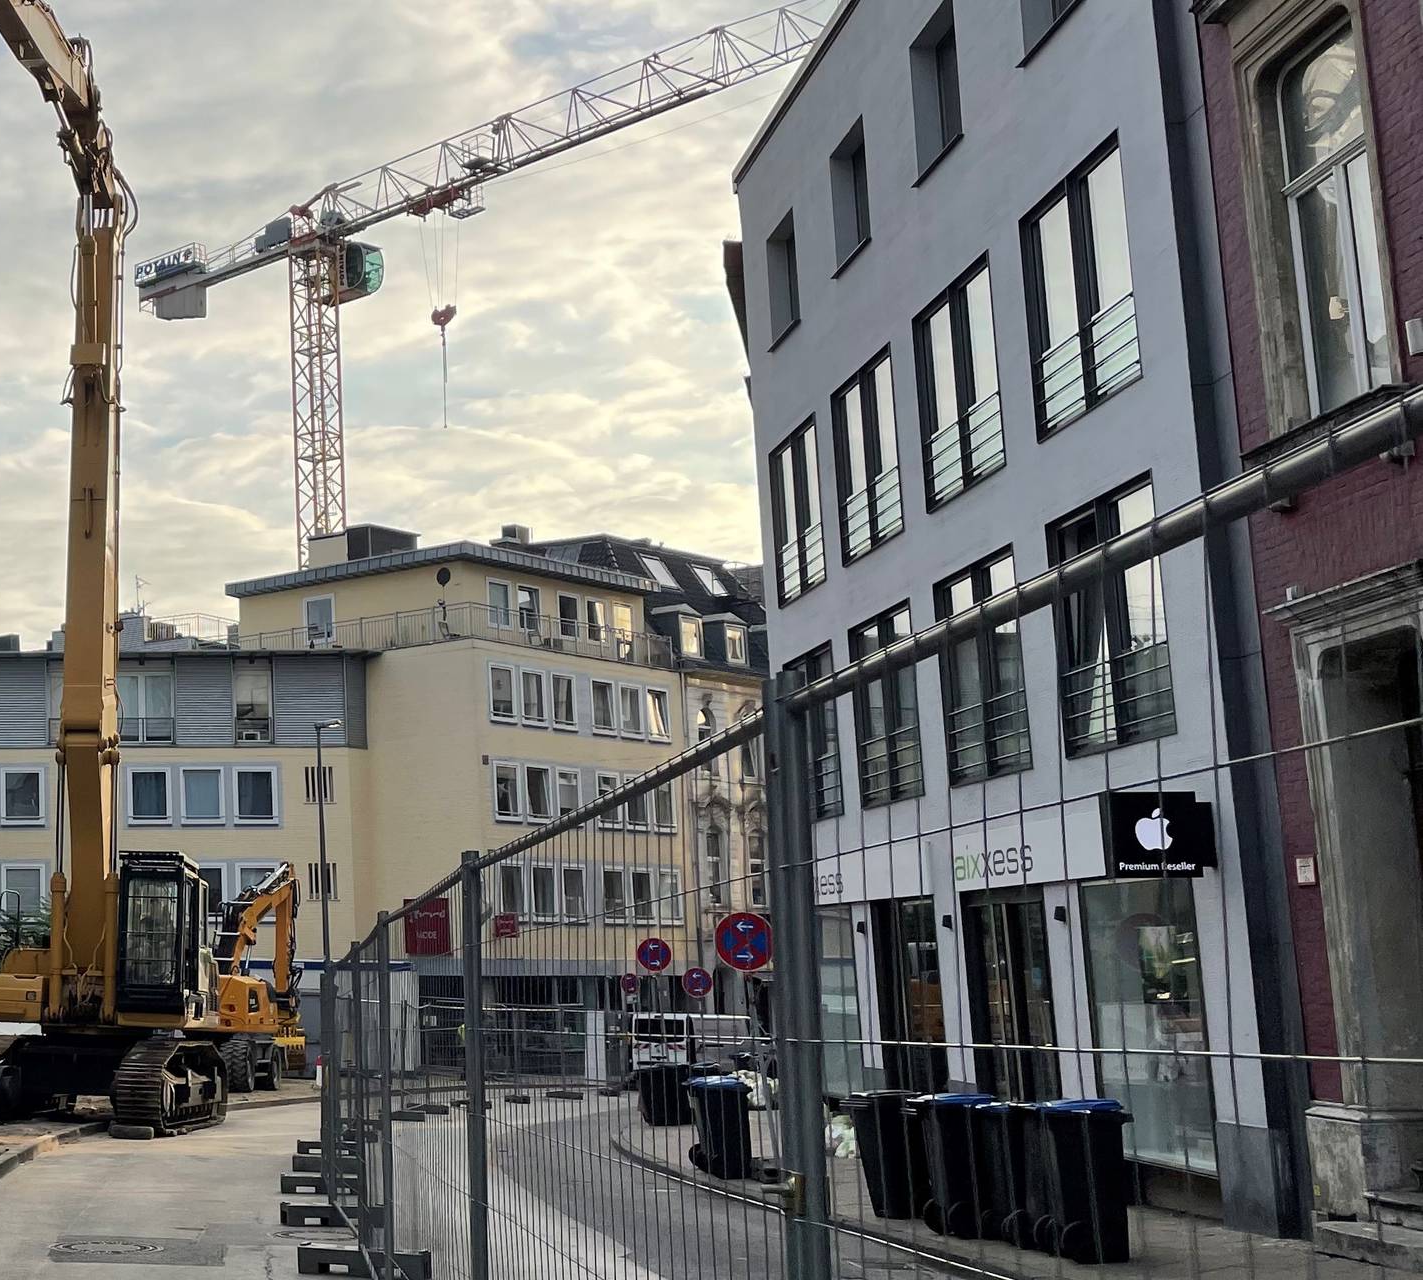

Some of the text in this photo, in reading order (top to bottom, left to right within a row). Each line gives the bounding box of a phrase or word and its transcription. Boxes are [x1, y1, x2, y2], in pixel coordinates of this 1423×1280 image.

[136, 251, 181, 279] POTAIN
[954, 844, 1034, 882] aixxess
[1119, 862, 1159, 870] Premium
